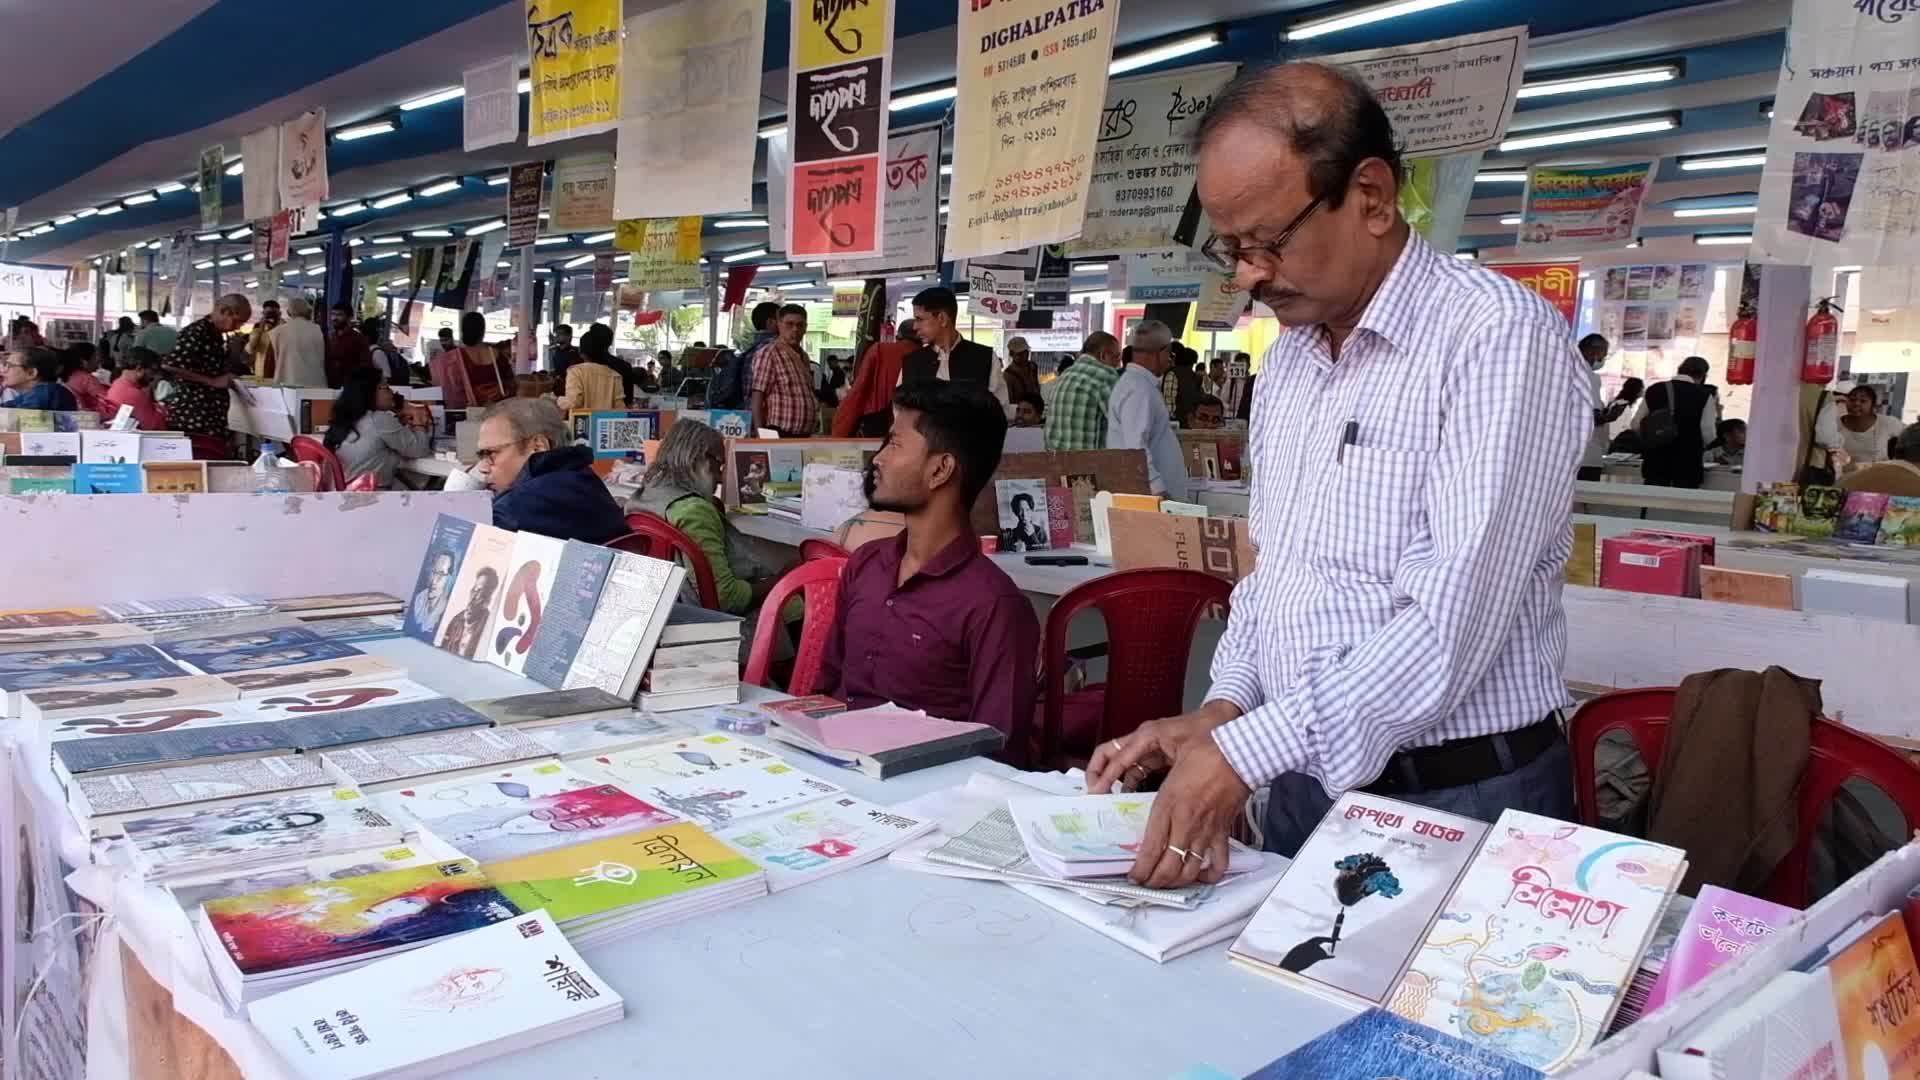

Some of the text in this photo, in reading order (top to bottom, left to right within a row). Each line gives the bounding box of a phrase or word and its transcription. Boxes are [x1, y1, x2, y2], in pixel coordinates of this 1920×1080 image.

[980, 0, 1105, 54] DIGHALPATRA
[1160, 162, 1198, 179] চট্টোপা
[1116, 186, 1173, 203] 8370993160
[632, 834, 718, 883] ত্রিনয়ন
